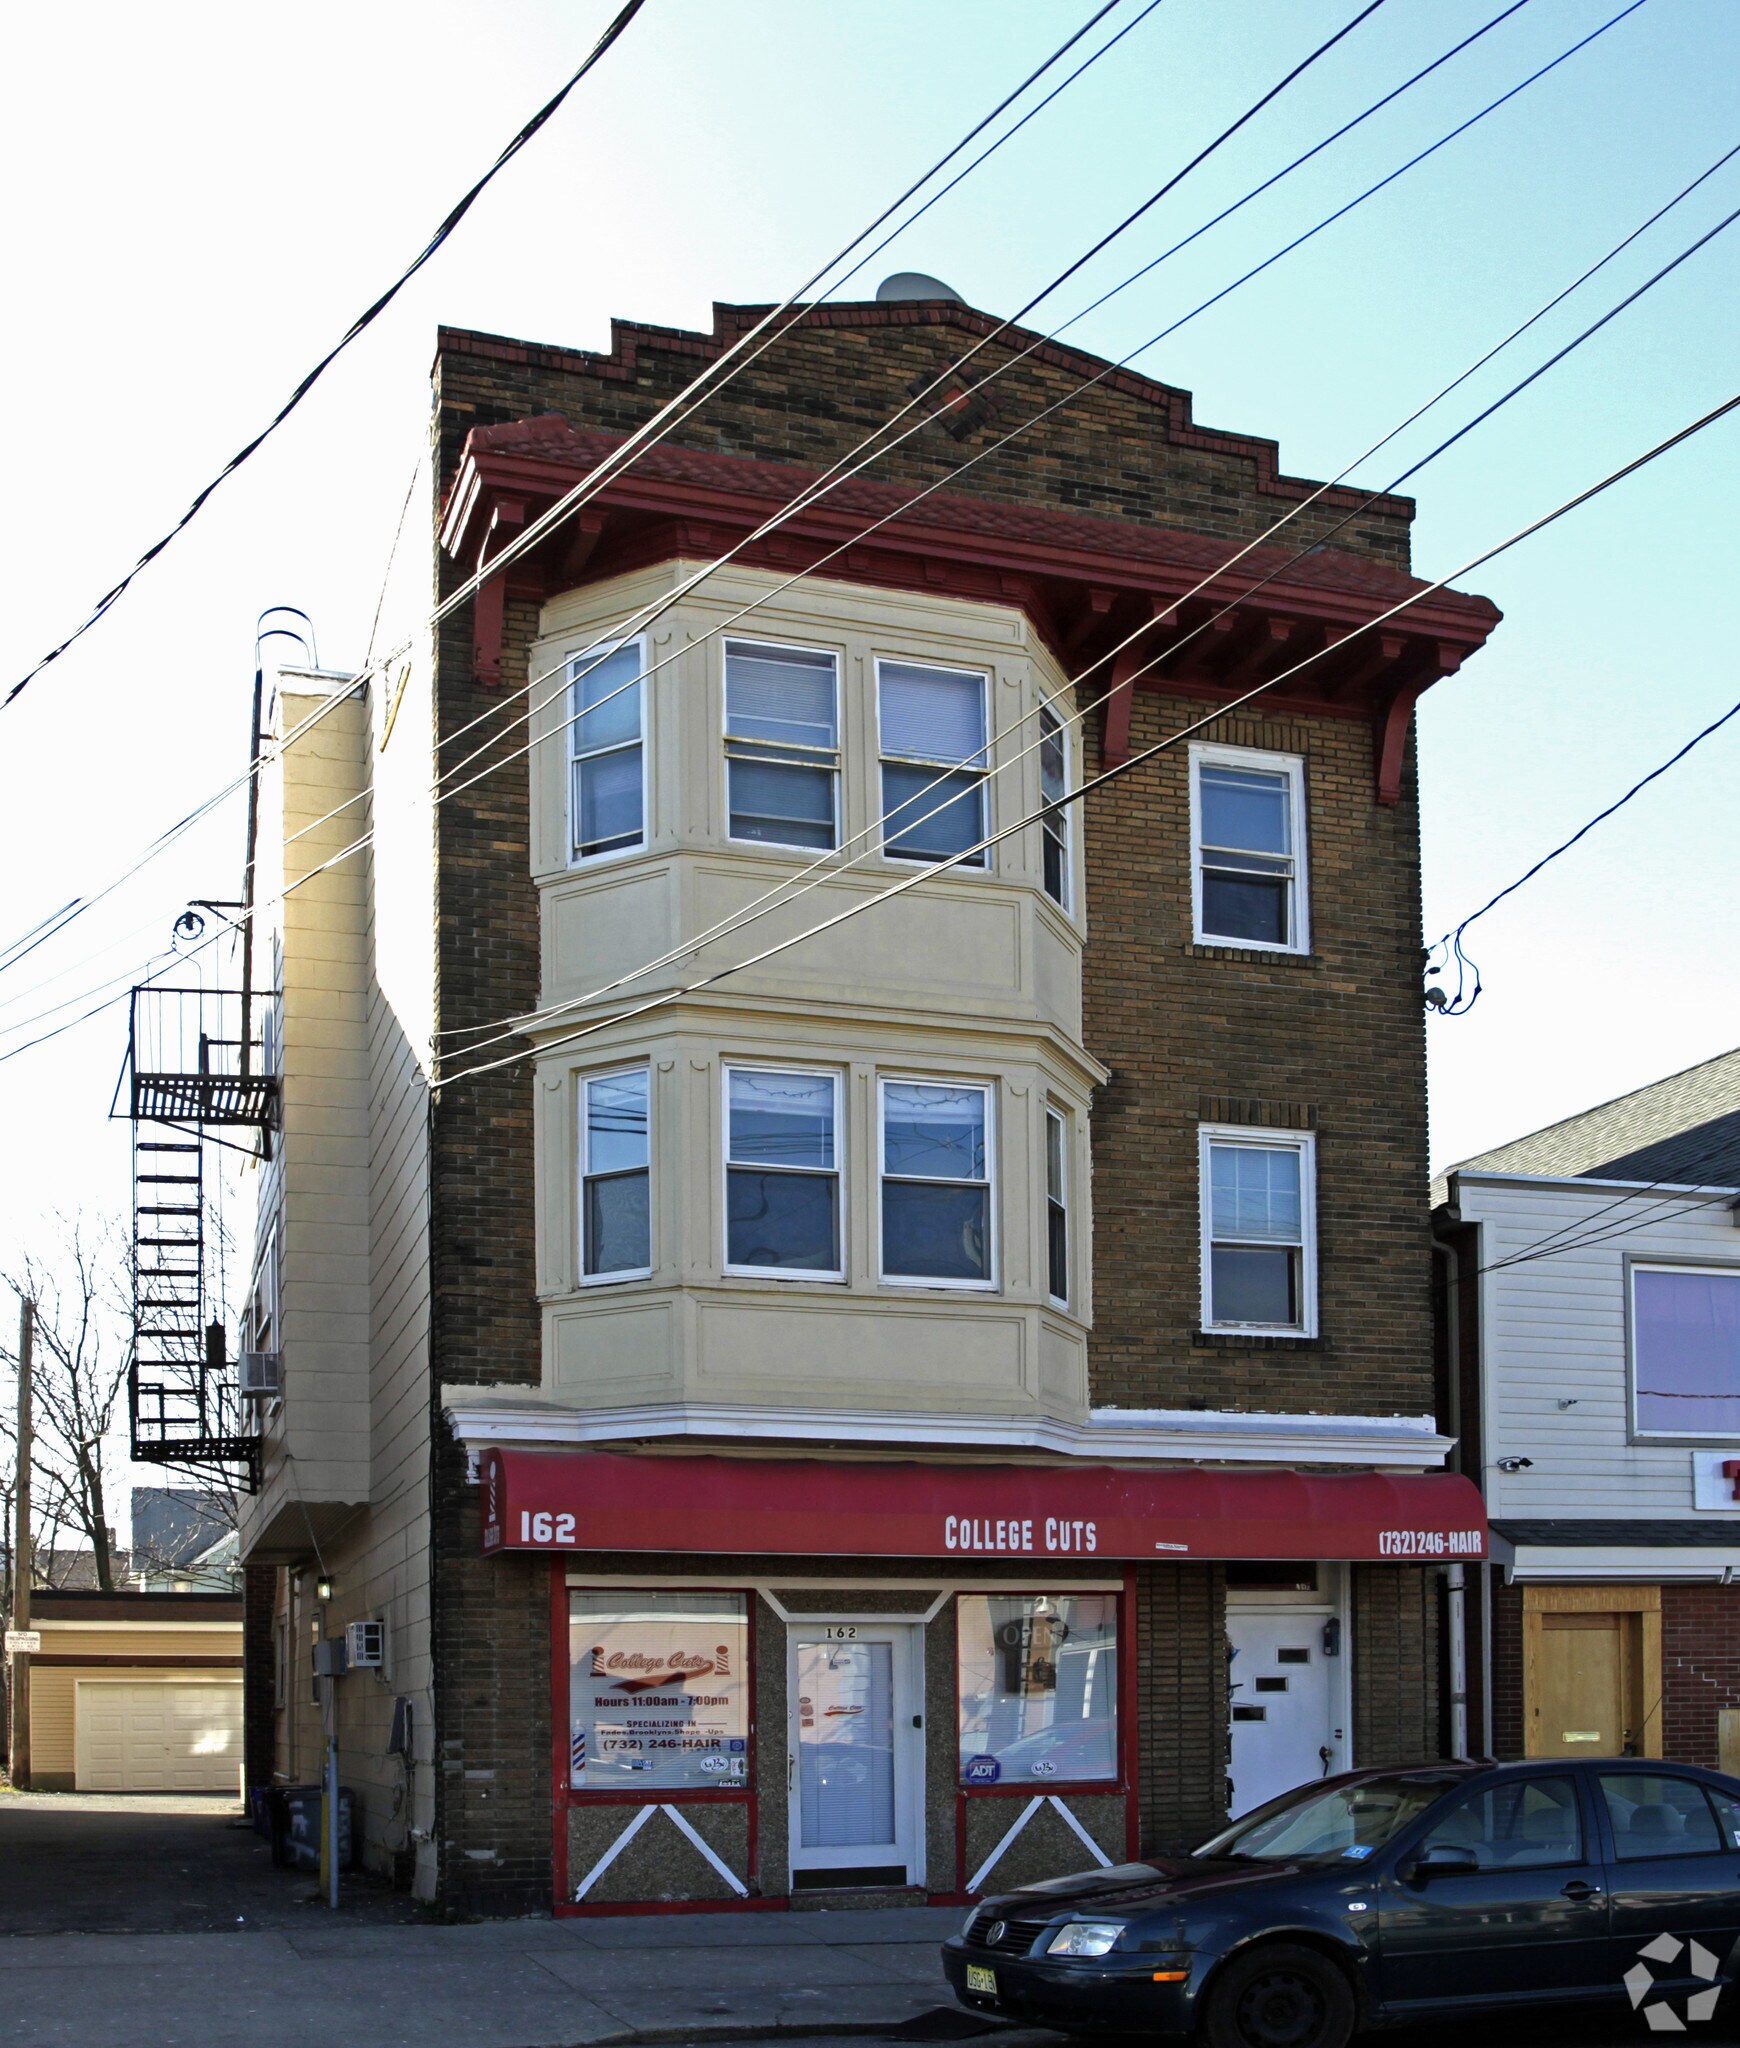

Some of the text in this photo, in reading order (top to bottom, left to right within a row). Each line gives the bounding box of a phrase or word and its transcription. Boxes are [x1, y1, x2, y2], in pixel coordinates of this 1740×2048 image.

[521, 1510, 576, 1543] 162
[945, 1515, 1097, 1551] COLLEGE CUTS
[826, 1627, 856, 1639] 162
[1003, 1626, 1058, 1646] OEN
[606, 1650, 704, 1674] College Cuts
[594, 1697, 630, 1707] Hours
[632, 1696, 679, 1707] 11:00am
[687, 1695, 729, 1707] 7:00pm
[626, 1720, 684, 1728] SPECIALIZING
[603, 1738, 721, 1751] (732) 246-HAIR
[971, 1765, 995, 1776] ADT
